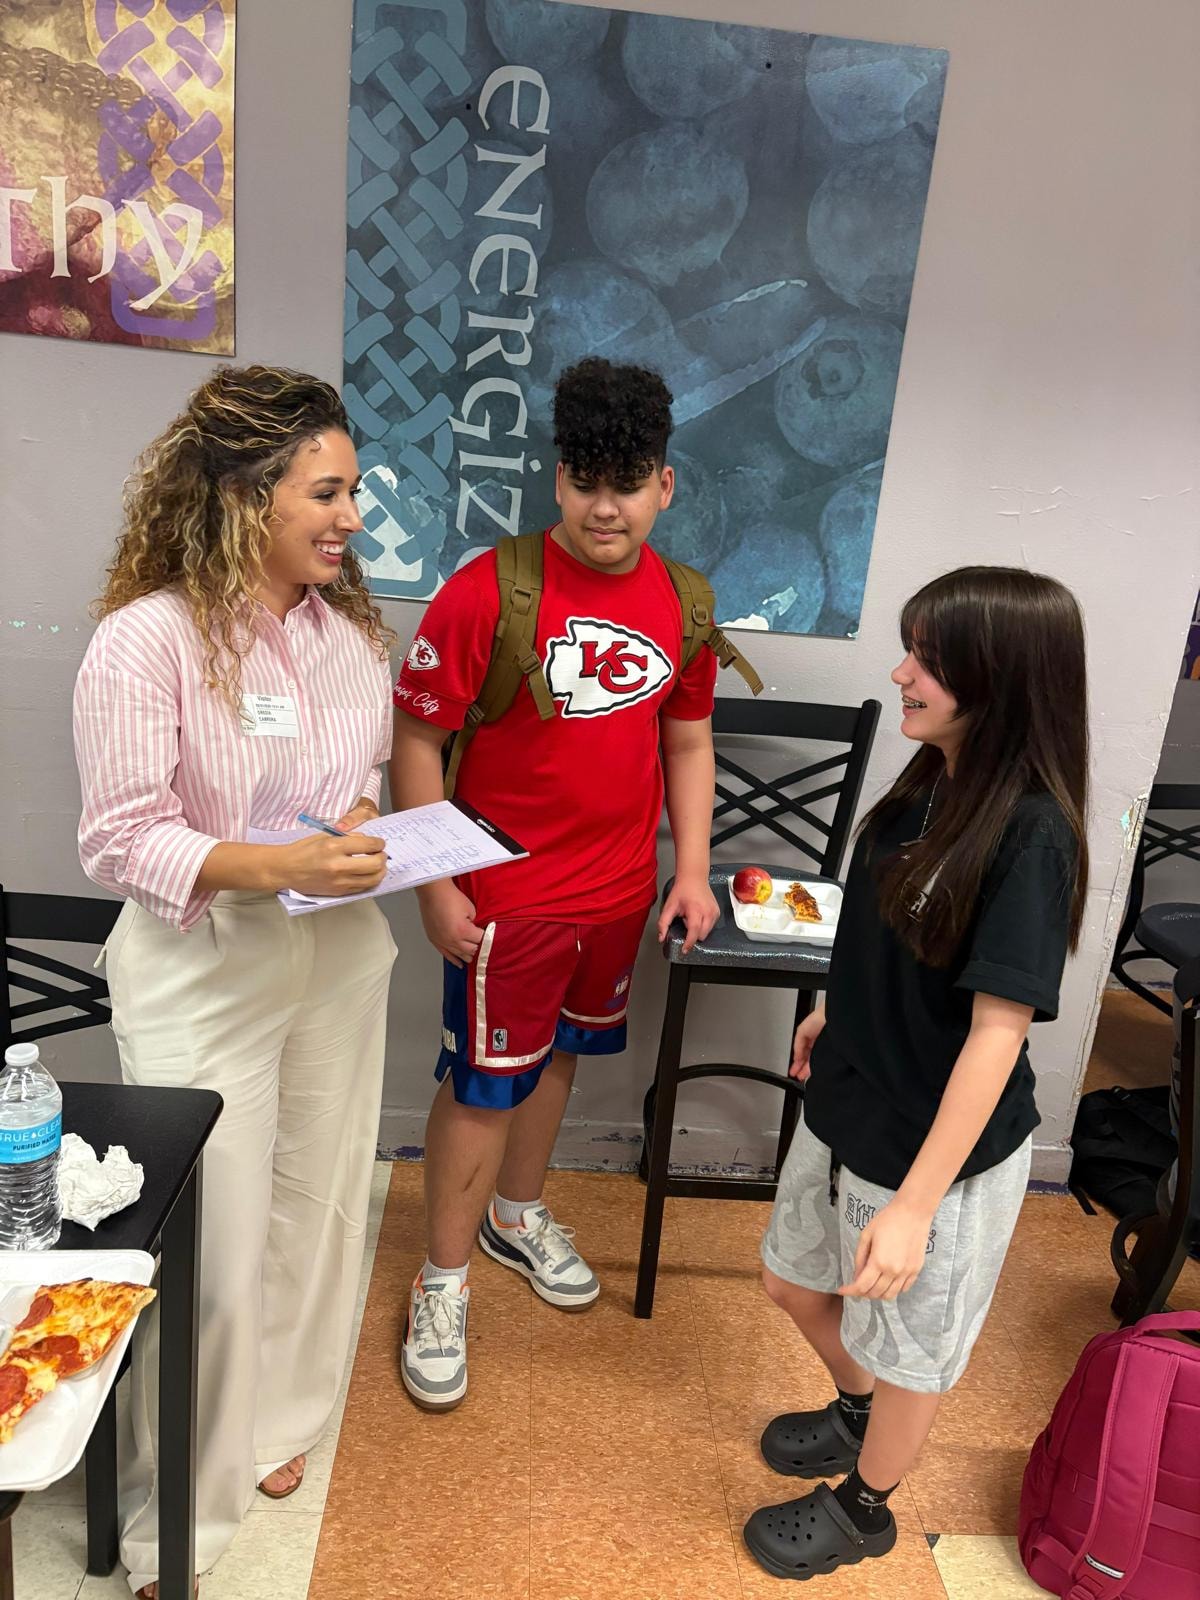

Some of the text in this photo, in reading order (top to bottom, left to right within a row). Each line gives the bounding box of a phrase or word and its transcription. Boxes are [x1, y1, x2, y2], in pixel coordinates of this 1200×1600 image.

[578, 640, 649, 694] KC
[412, 692, 440, 716] City
[0, 1131, 30, 1143] TRUE
[12, 1141, 41, 1151] PURIFIED
